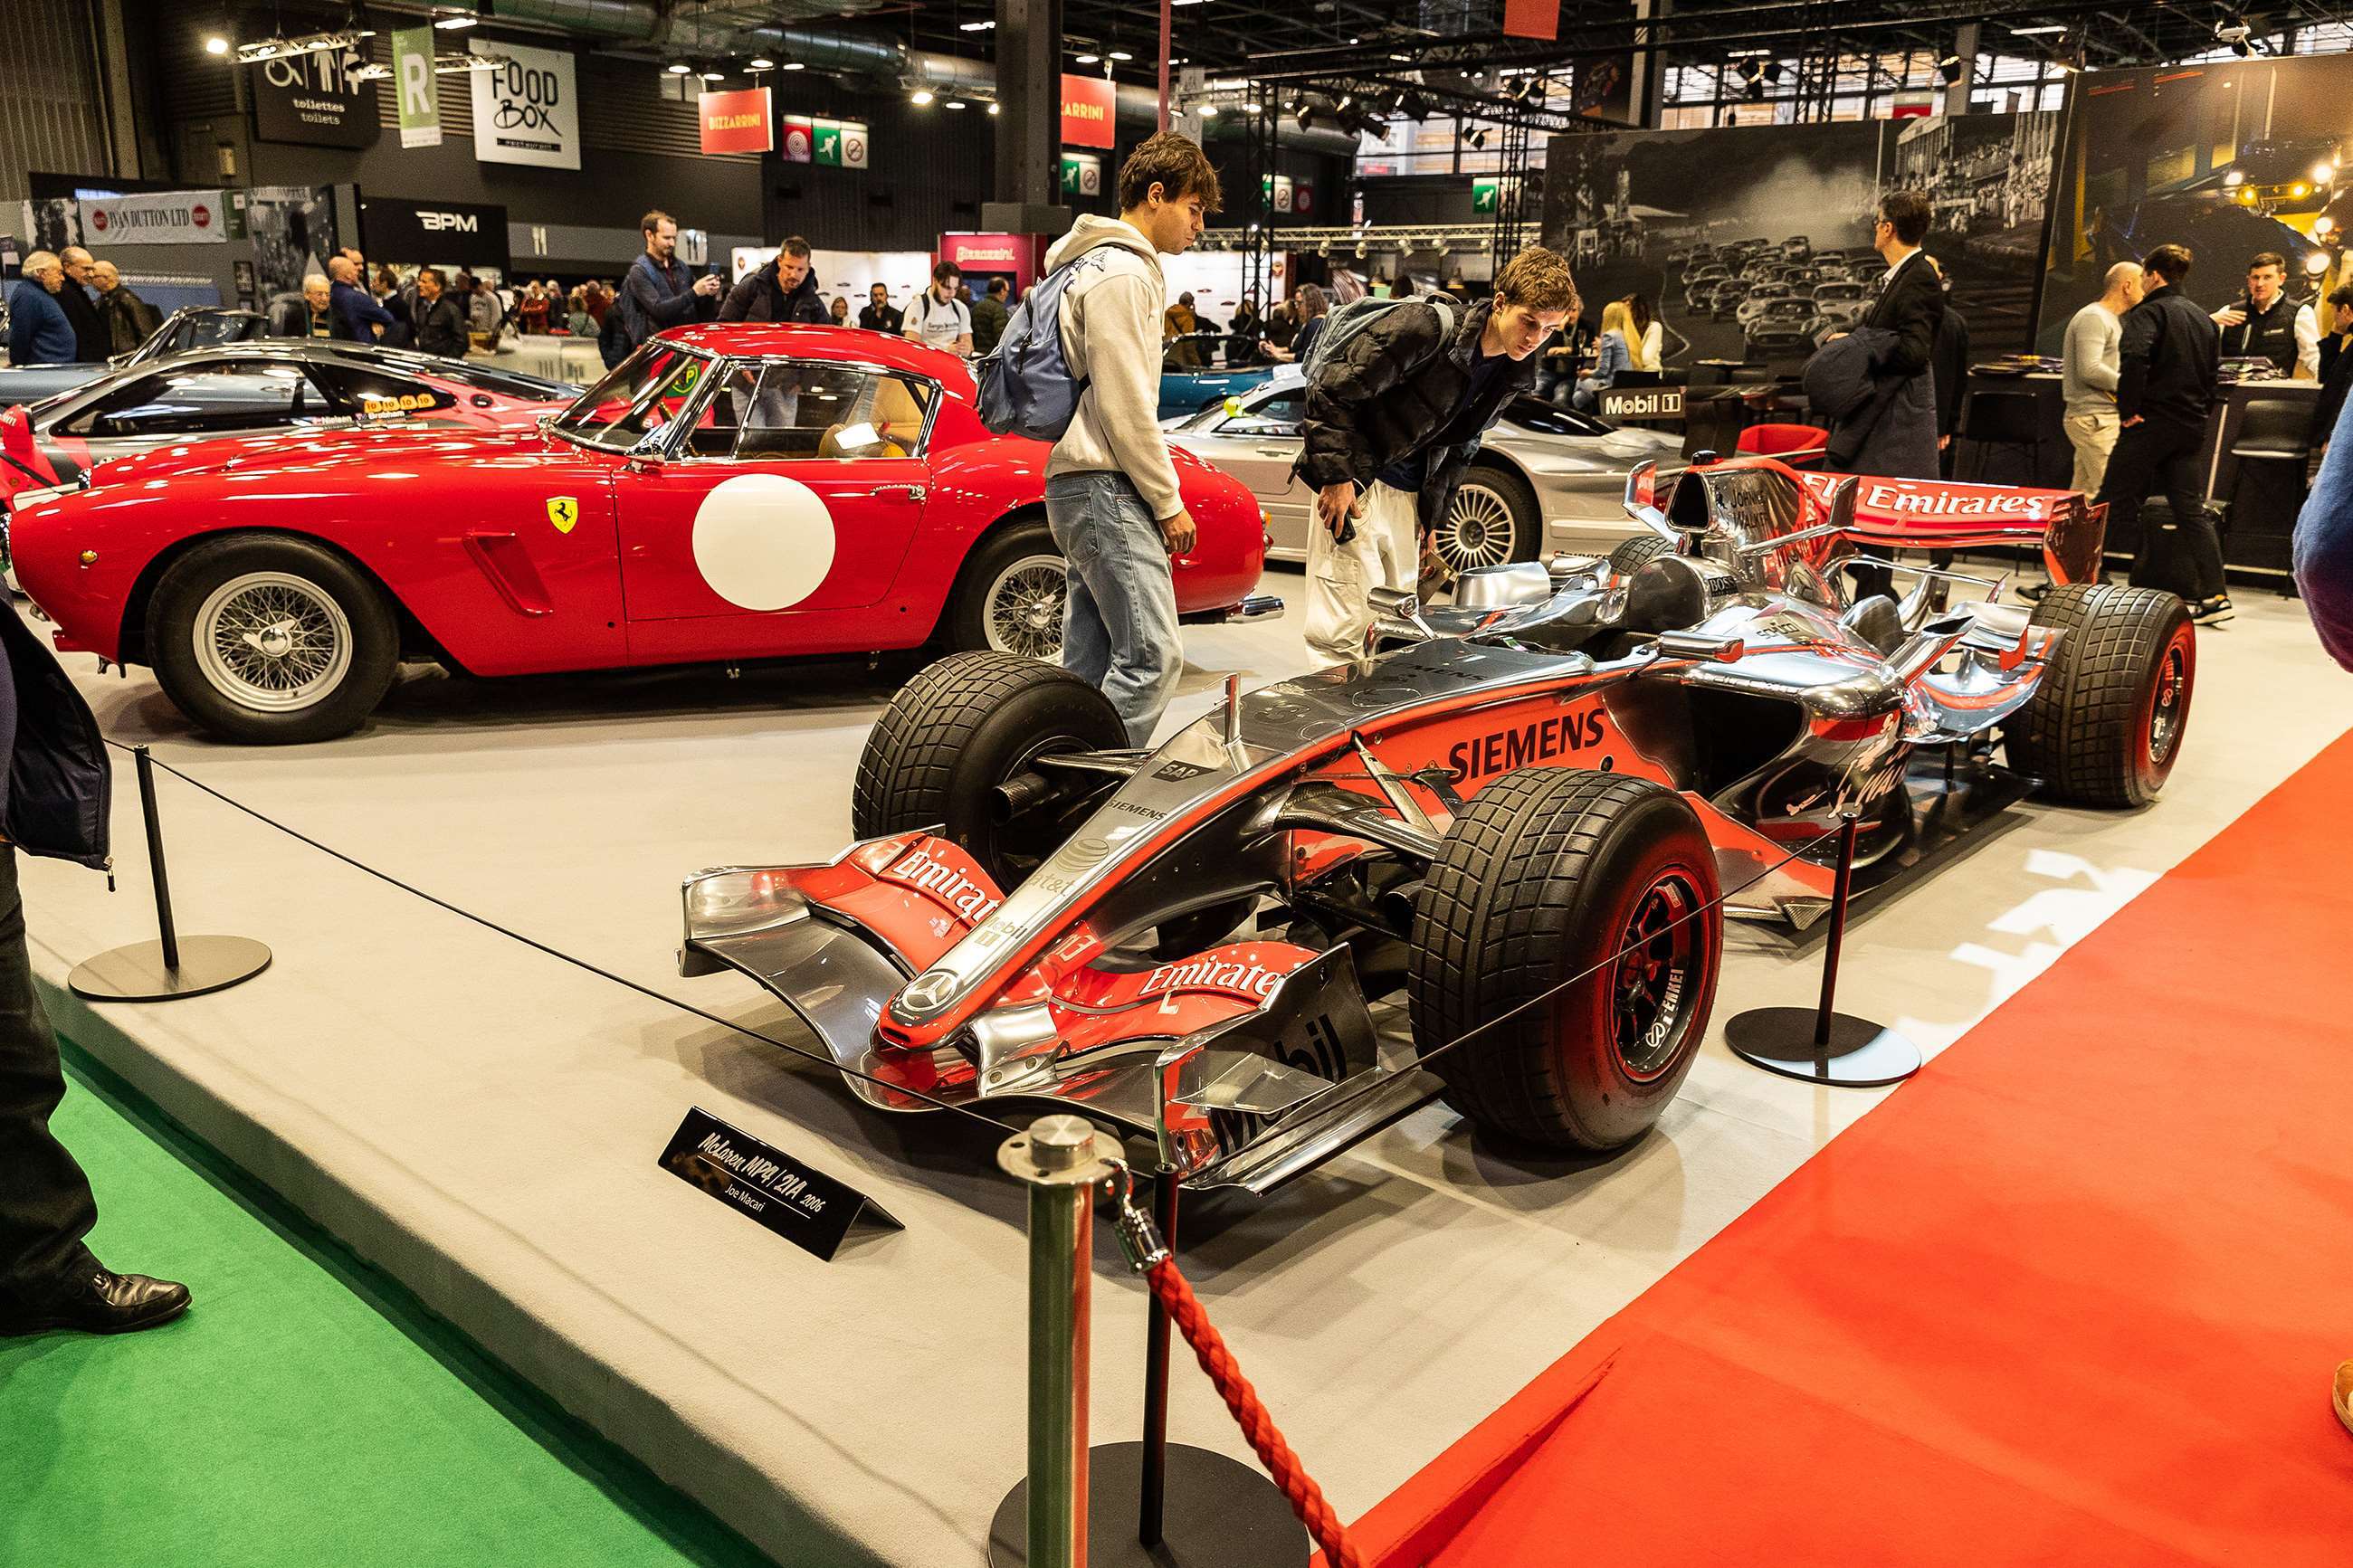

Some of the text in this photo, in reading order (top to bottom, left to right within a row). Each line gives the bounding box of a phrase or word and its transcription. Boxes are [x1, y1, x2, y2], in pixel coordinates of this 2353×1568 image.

[401, 52, 432, 116] R
[492, 61, 558, 106] FOOD
[292, 98, 346, 113] toilettes
[300, 112, 341, 125] toilets
[709, 113, 761, 131] BIZZARRINI
[131, 209, 169, 228] DUTTON
[170, 208, 190, 227] LTD
[415, 211, 479, 233] BPM
[366, 397, 430, 411] 10 10 10 10
[1605, 394, 1658, 415] Mobil
[1866, 483, 2044, 515] Emirates
[1709, 577, 1736, 593] BOSS
[1448, 708, 1605, 785] SIEMENS
[1157, 764, 1201, 780] SAP
[1107, 799, 1167, 822] SIEMENS
[892, 850, 1001, 923] Emirat
[1138, 954, 1283, 997] Emirate
[1662, 968, 1684, 1012] ENKEI
[697, 1132, 747, 1172] McLaren
[799, 1193, 826, 1212] 2006
[724, 1183, 767, 1212] Joe Macari
